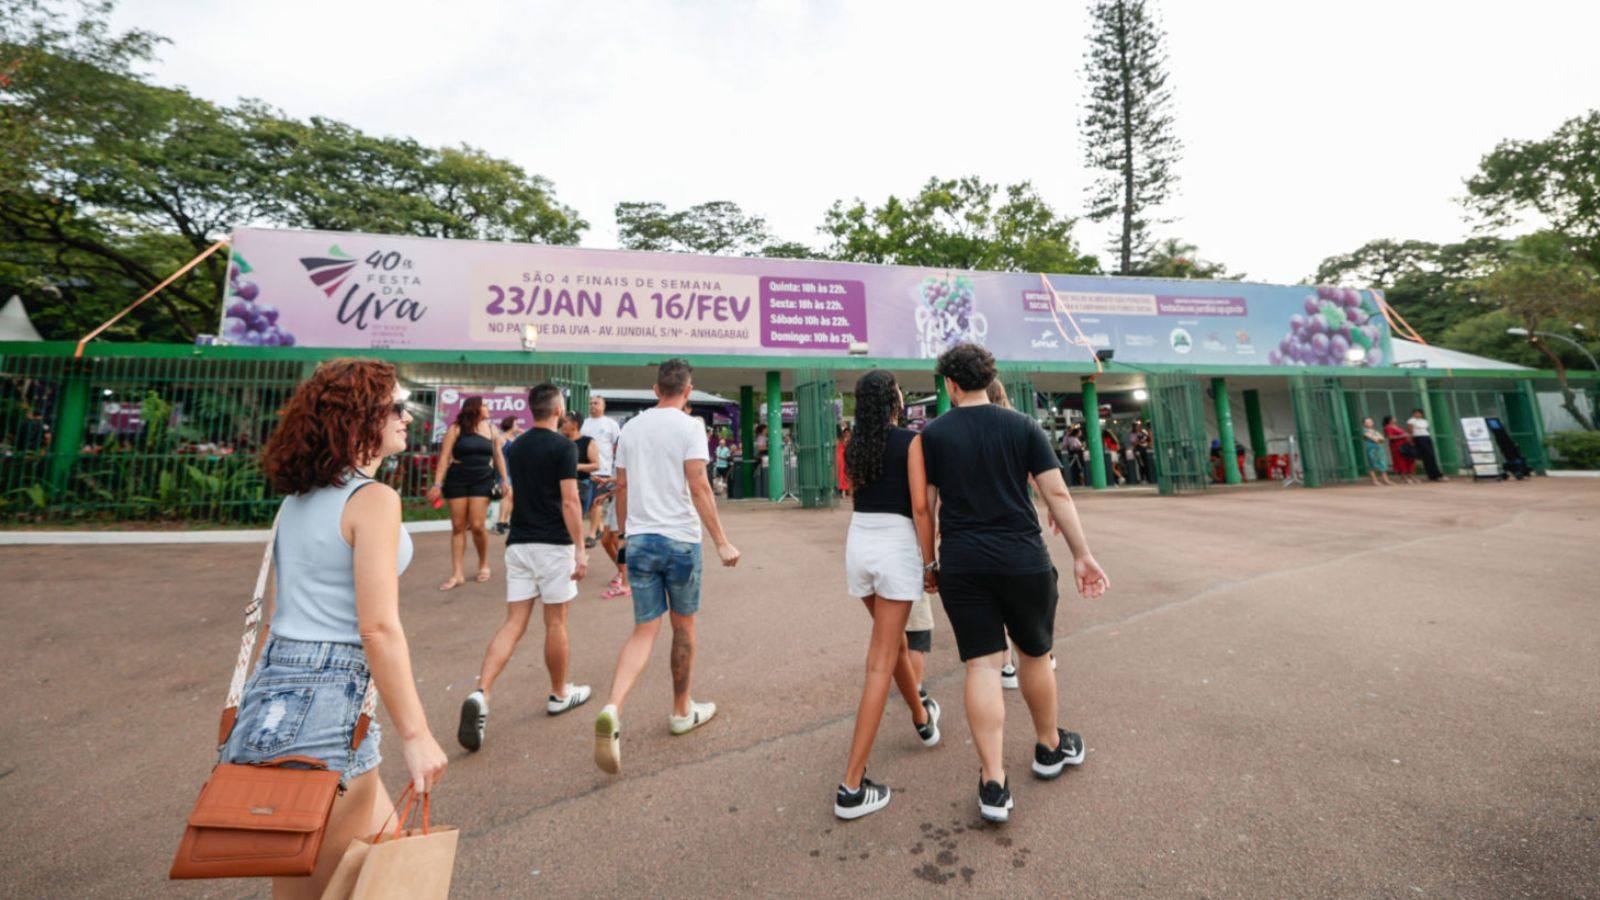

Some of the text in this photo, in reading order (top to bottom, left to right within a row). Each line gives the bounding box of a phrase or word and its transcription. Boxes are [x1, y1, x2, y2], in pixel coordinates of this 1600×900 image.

[366, 274, 421, 285] FESTA
[522, 271, 722, 291] SÃO 4 FINAIS DE SEMANA
[382, 286, 405, 295] DA
[769, 281, 801, 293] Quinta:
[818, 283, 827, 294] às
[829, 284, 847, 294] 22h.
[336, 283, 427, 330] Uva
[486, 284, 751, 322] 23/JAN A 16/FEV
[770, 298, 798, 309] Sexta:
[815, 300, 824, 310] às
[826, 300, 843, 311] 22h.
[770, 313, 849, 327] Sábado 10h às 22h.
[488, 322, 504, 333] NO
[506, 323, 550, 335] PAUE
[552, 324, 567, 335] DA
[569, 325, 590, 336] UVA
[598, 325, 614, 337] AV.
[771, 331, 812, 344] Domingo:
[814, 332, 828, 343] 10h
[830, 332, 839, 343] às
